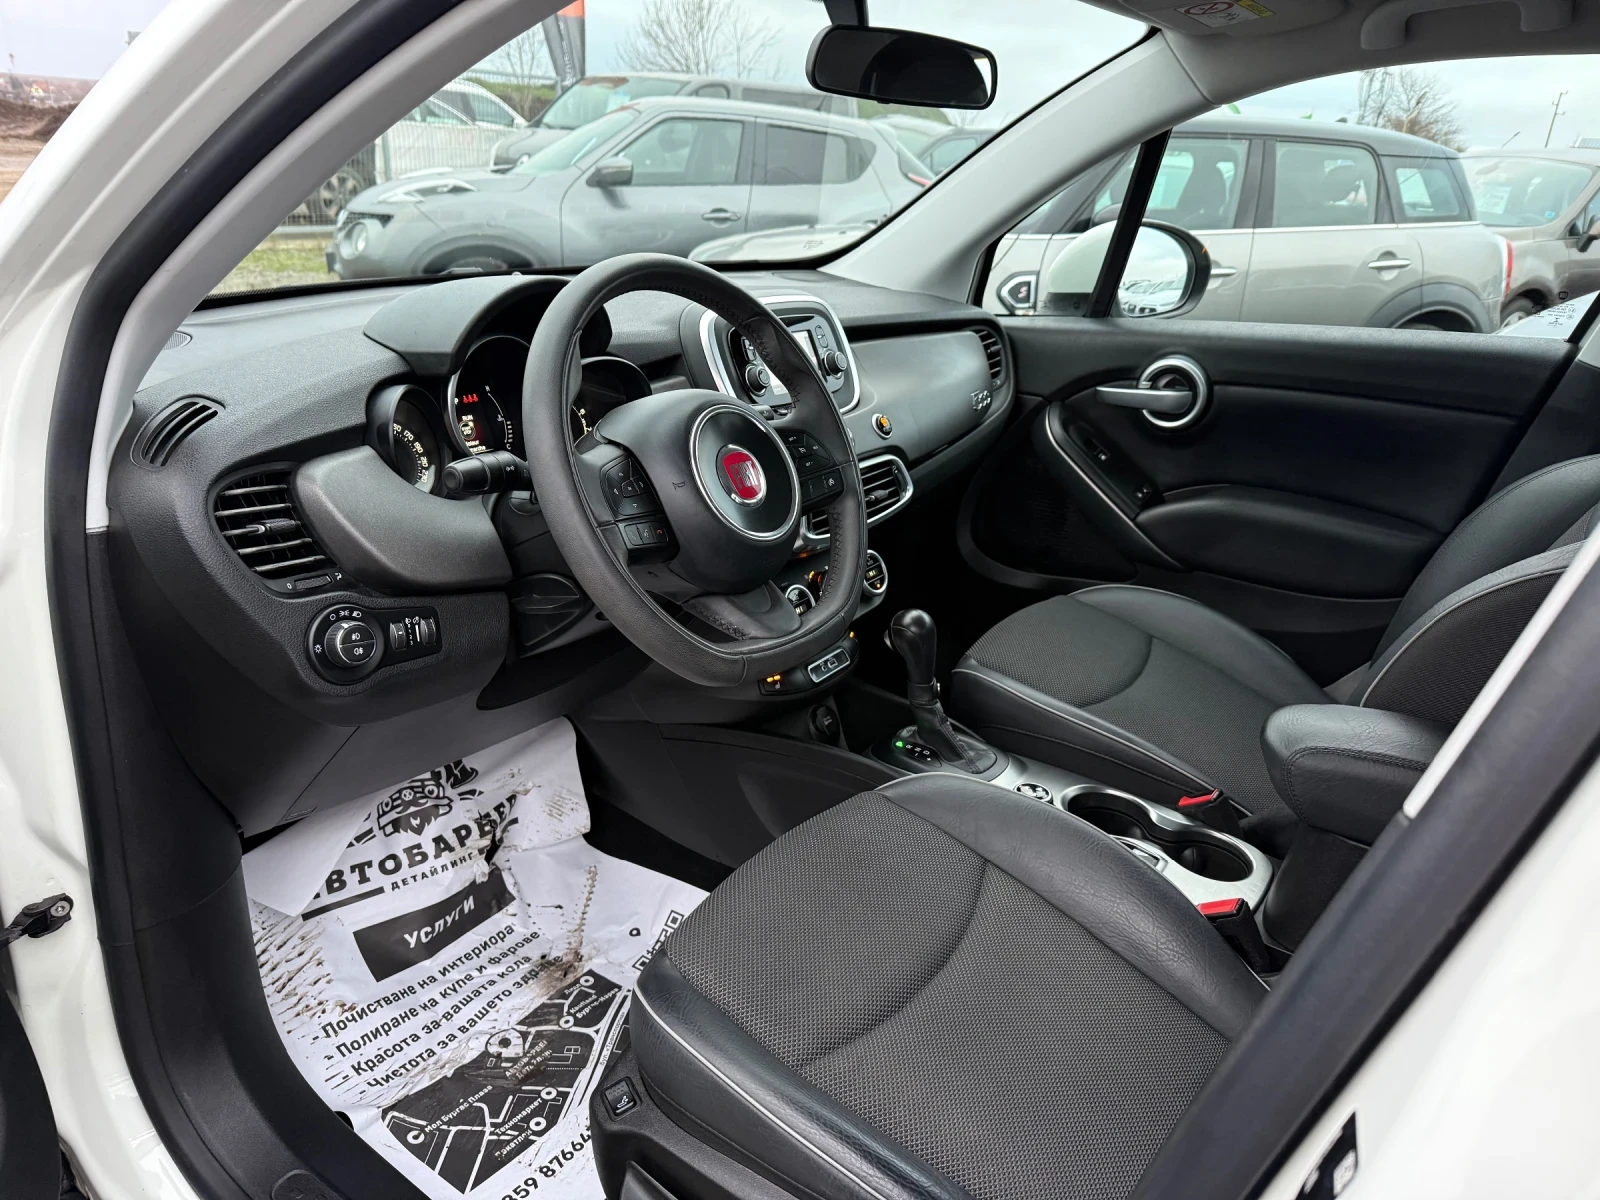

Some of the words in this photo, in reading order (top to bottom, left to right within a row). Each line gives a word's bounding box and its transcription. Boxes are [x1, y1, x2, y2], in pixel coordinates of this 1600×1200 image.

[403, 430, 414, 441] 170
[413, 441, 424, 453] 190
[730, 460, 759, 489] FIAT
[313, 793, 517, 900] ВТОБАРБЕР
[391, 851, 474, 891] ДЕТАЙЛИНГ
[404, 895, 475, 949] УСЛУГИ
[321, 984, 418, 1039] Почистване
[417, 974, 439, 990] на
[438, 924, 514, 977] интериора
[335, 1006, 420, 1058] Полиране
[419, 999, 439, 1012] на
[439, 974, 474, 999] купе
[475, 965, 487, 975] и
[488, 930, 541, 966] фарове
[569, 994, 598, 1014] Kaufland
[351, 1033, 421, 1076] Красота
[421, 1019, 442, 1034] за
[441, 979, 497, 1022] вашата
[497, 956, 533, 979] кола
[366, 1048, 437, 1088] Чистота
[437, 1033, 458, 1049] за
[457, 989, 512, 1034] вашето
[512, 955, 564, 989] здрае
[424, 1120, 443, 1133] Мол
[441, 1102, 469, 1123] Бургас
[468, 1084, 493, 1104] Плаза
[494, 1098, 543, 1136] Техномаркет
[539, 1124, 592, 1178] 87664
